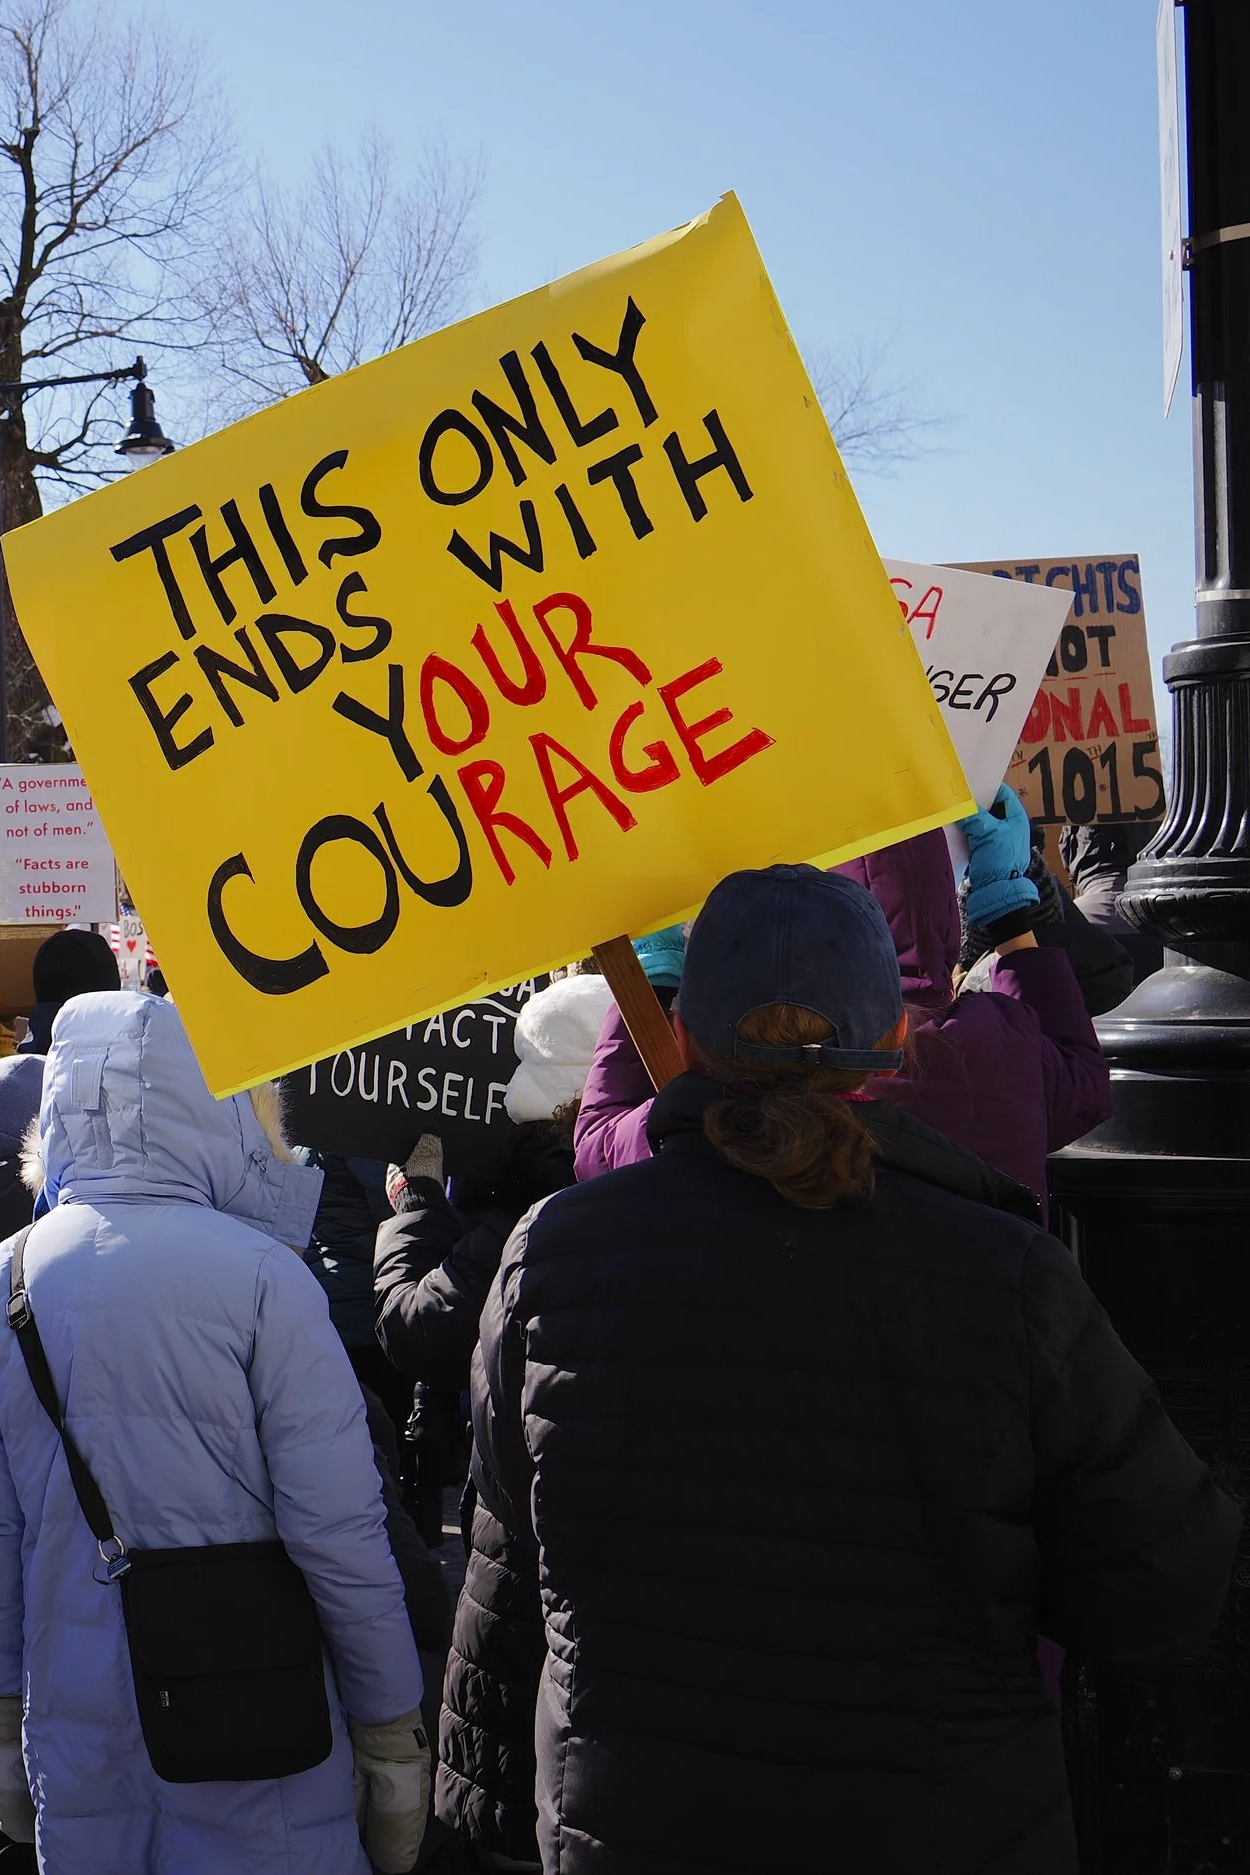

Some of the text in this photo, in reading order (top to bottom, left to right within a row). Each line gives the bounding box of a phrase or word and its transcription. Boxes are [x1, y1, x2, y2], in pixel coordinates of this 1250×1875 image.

[108, 295, 659, 641] THIS ONLY
[127, 408, 754, 770] ENDS WITH
[331, 592, 653, 783] YOUR
[926, 665, 1017, 723] GER
[5, 797, 93, 814] of laws, and
[6, 826, 28, 838] not
[34, 824, 49, 837] of
[207, 656, 776, 996] COURAGE
[19, 881, 86, 894] stubborn
[65, 859, 89, 870] are
